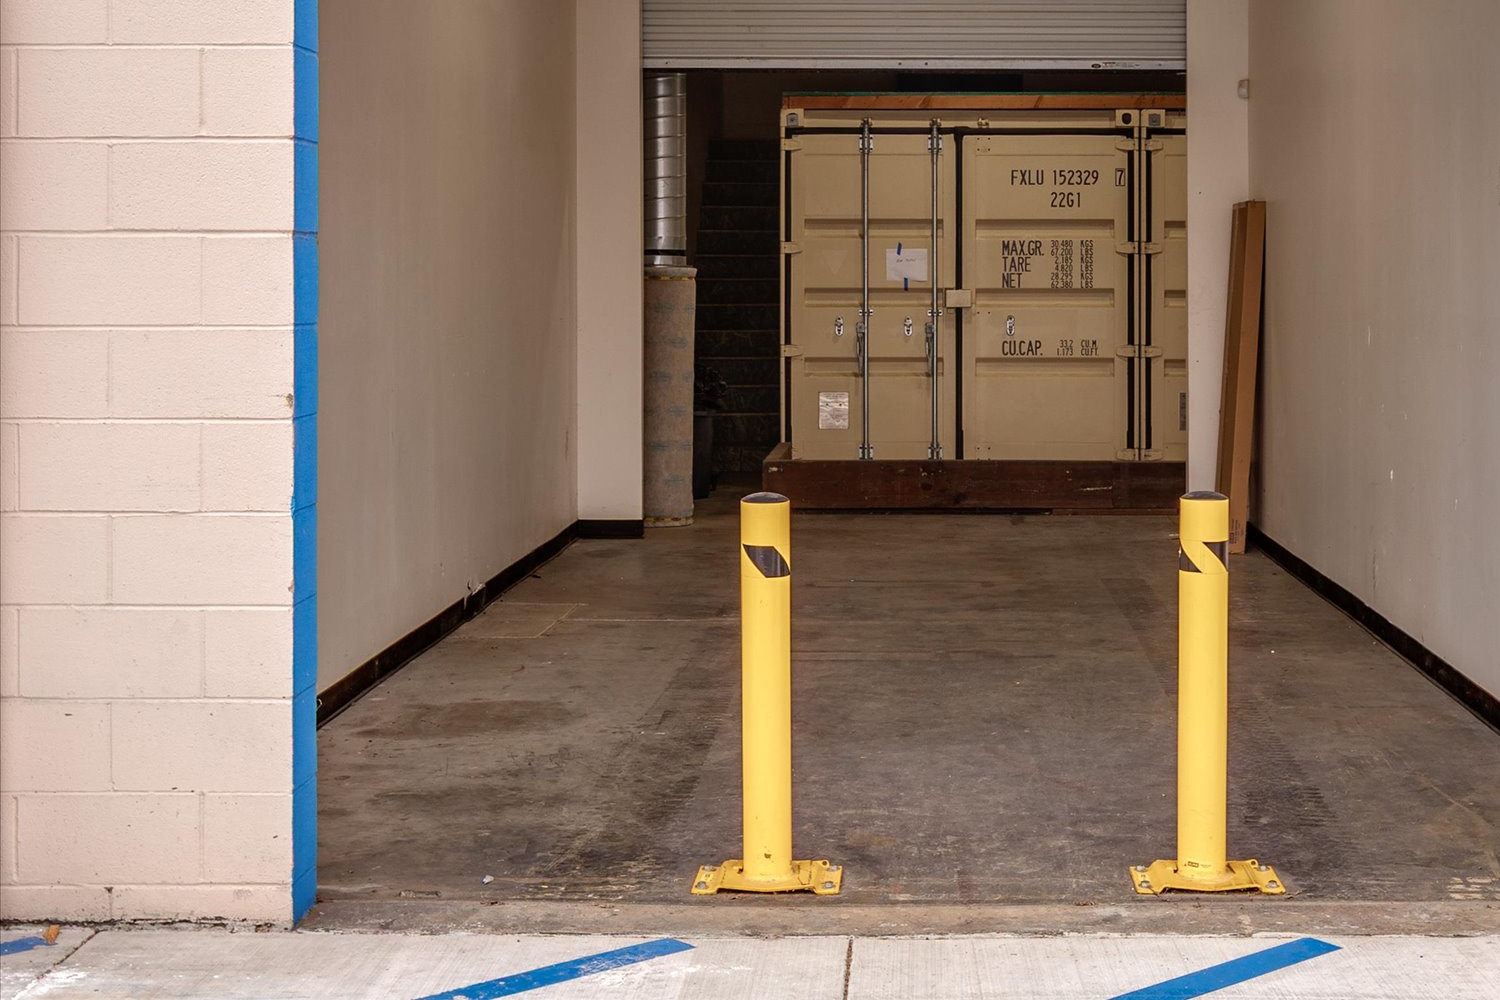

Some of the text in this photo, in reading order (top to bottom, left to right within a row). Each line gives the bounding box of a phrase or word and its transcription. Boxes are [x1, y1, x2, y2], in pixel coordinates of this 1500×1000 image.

[1011, 169, 1124, 185] FXLU 152329 7
[1051, 192, 1080, 208] 22G1
[1002, 240, 1044, 256] MAX.GR.
[1080, 240, 1093, 248] KGS
[1080, 248, 1093, 256] LBS
[1002, 257, 1031, 272] TARE
[1080, 256, 1093, 264] KGS
[1080, 264, 1093, 272] LBS
[1002, 273, 1022, 288] NET
[1080, 272, 1093, 280] KGS
[1080, 280, 1093, 288] LBS
[1002, 341, 1043, 356] CU.CAP.
